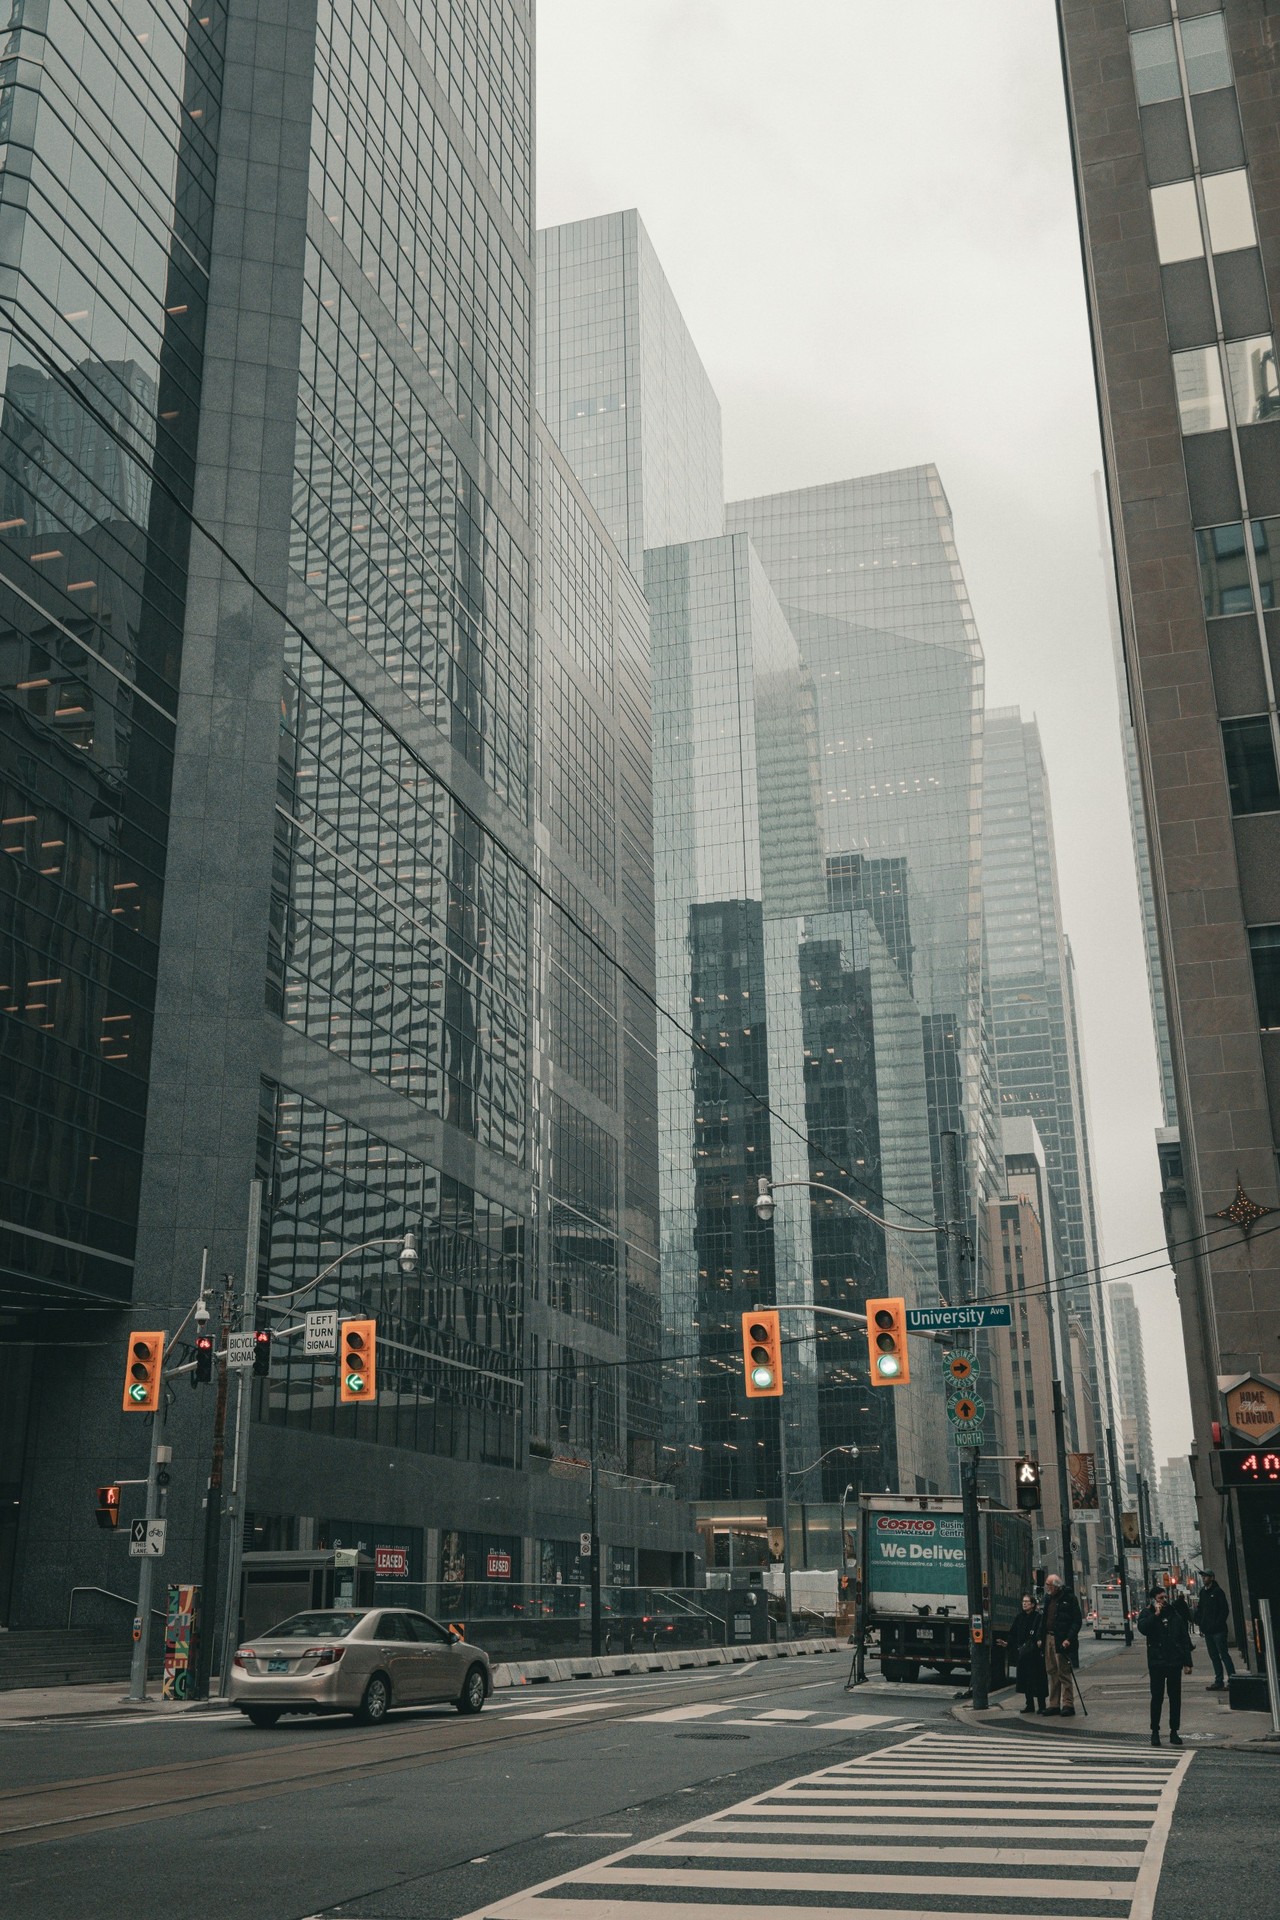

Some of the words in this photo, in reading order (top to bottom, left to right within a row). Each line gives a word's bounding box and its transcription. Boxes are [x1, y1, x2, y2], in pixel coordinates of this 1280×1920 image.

[310, 1315, 333, 1325] LEFT
[910, 1308, 985, 1326] University
[990, 1307, 1005, 1315] Ave
[309, 1328, 334, 1337] TURN
[306, 1340, 335, 1350] SIGNAL
[230, 1352, 255, 1363] SIGNAL
[944, 1349, 976, 1364] GARDINER
[943, 1368, 979, 1388] EXPRESSWAY
[947, 1396, 957, 1410] DON
[960, 1390, 984, 1408] VALLEY
[1239, 1390, 1265, 1404] HOME
[1238, 1400, 1268, 1416] Made
[952, 1415, 982, 1429] PARKWAY
[1235, 1410, 1275, 1425] FLAVOUR
[956, 1432, 982, 1445] NORTH
[1086, 1456, 1096, 1486] BEAUTY
[877, 1516, 936, 1531] COSTCO
[880, 1543, 907, 1558] We
[377, 1554, 403, 1569] LEASED
[489, 1559, 509, 1573] LEASED
